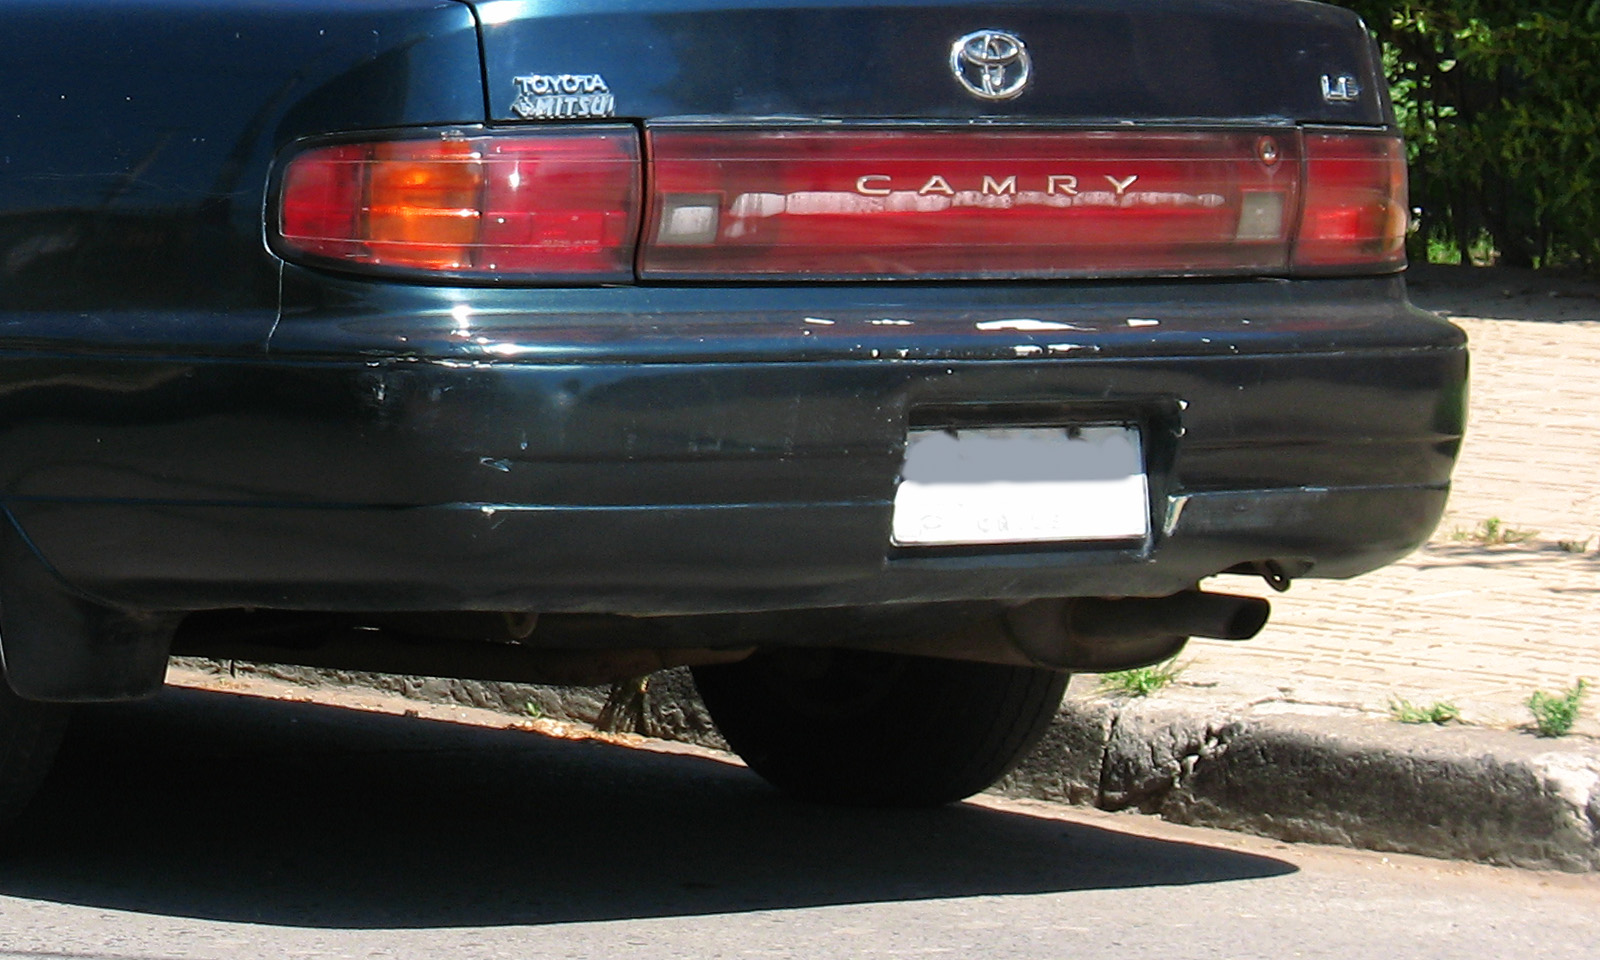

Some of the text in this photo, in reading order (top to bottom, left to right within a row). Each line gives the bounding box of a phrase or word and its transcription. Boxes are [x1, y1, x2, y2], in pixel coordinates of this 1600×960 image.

[514, 74, 609, 95] TOYOTA
[534, 94, 615, 117] MITSUI
[856, 174, 1138, 195] CAMRY
